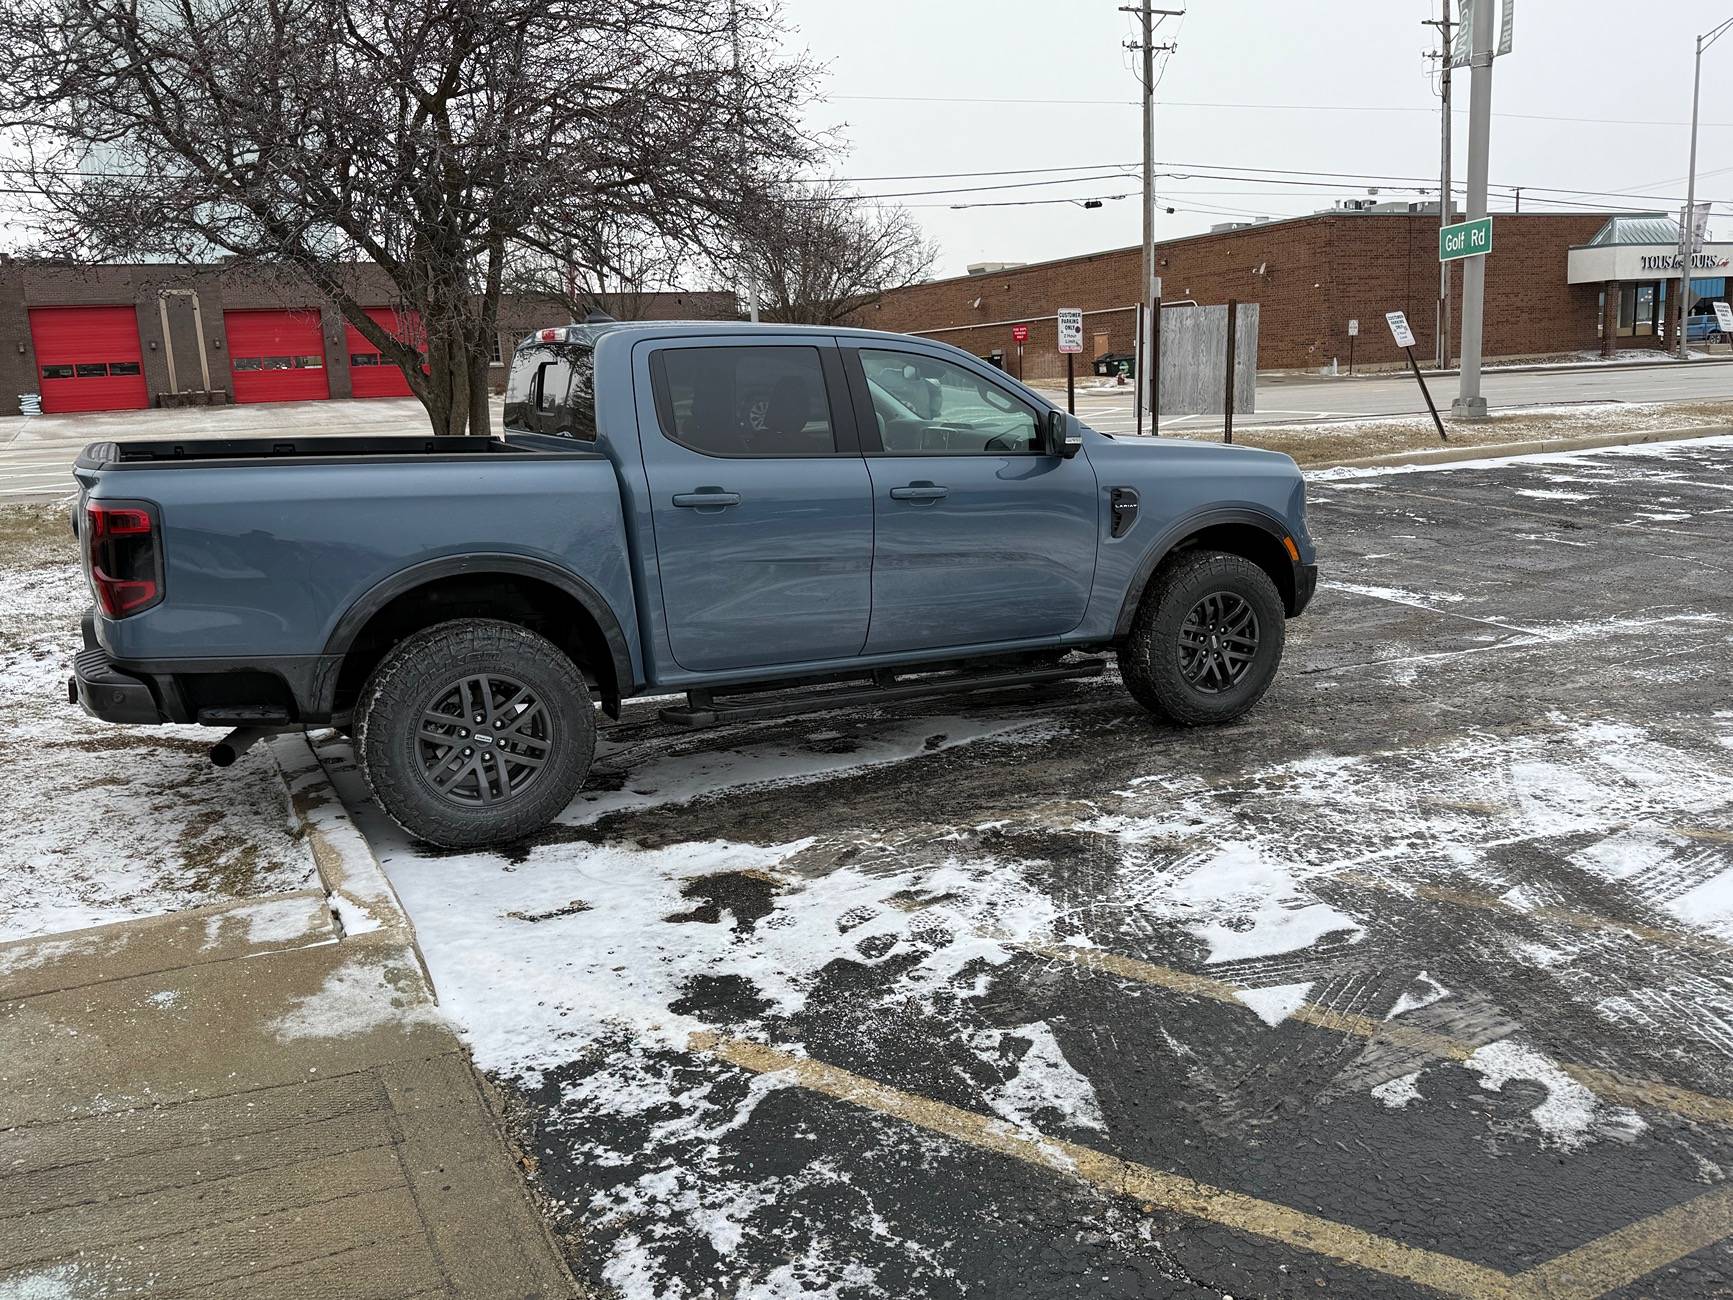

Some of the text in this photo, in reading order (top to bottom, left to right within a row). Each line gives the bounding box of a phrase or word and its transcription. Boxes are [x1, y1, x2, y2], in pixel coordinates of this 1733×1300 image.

[1500, 0, 1512, 51] ARLIN
[1445, 227, 1485, 252] Golf Rd
[1641, 255, 1672, 269] TOUS
